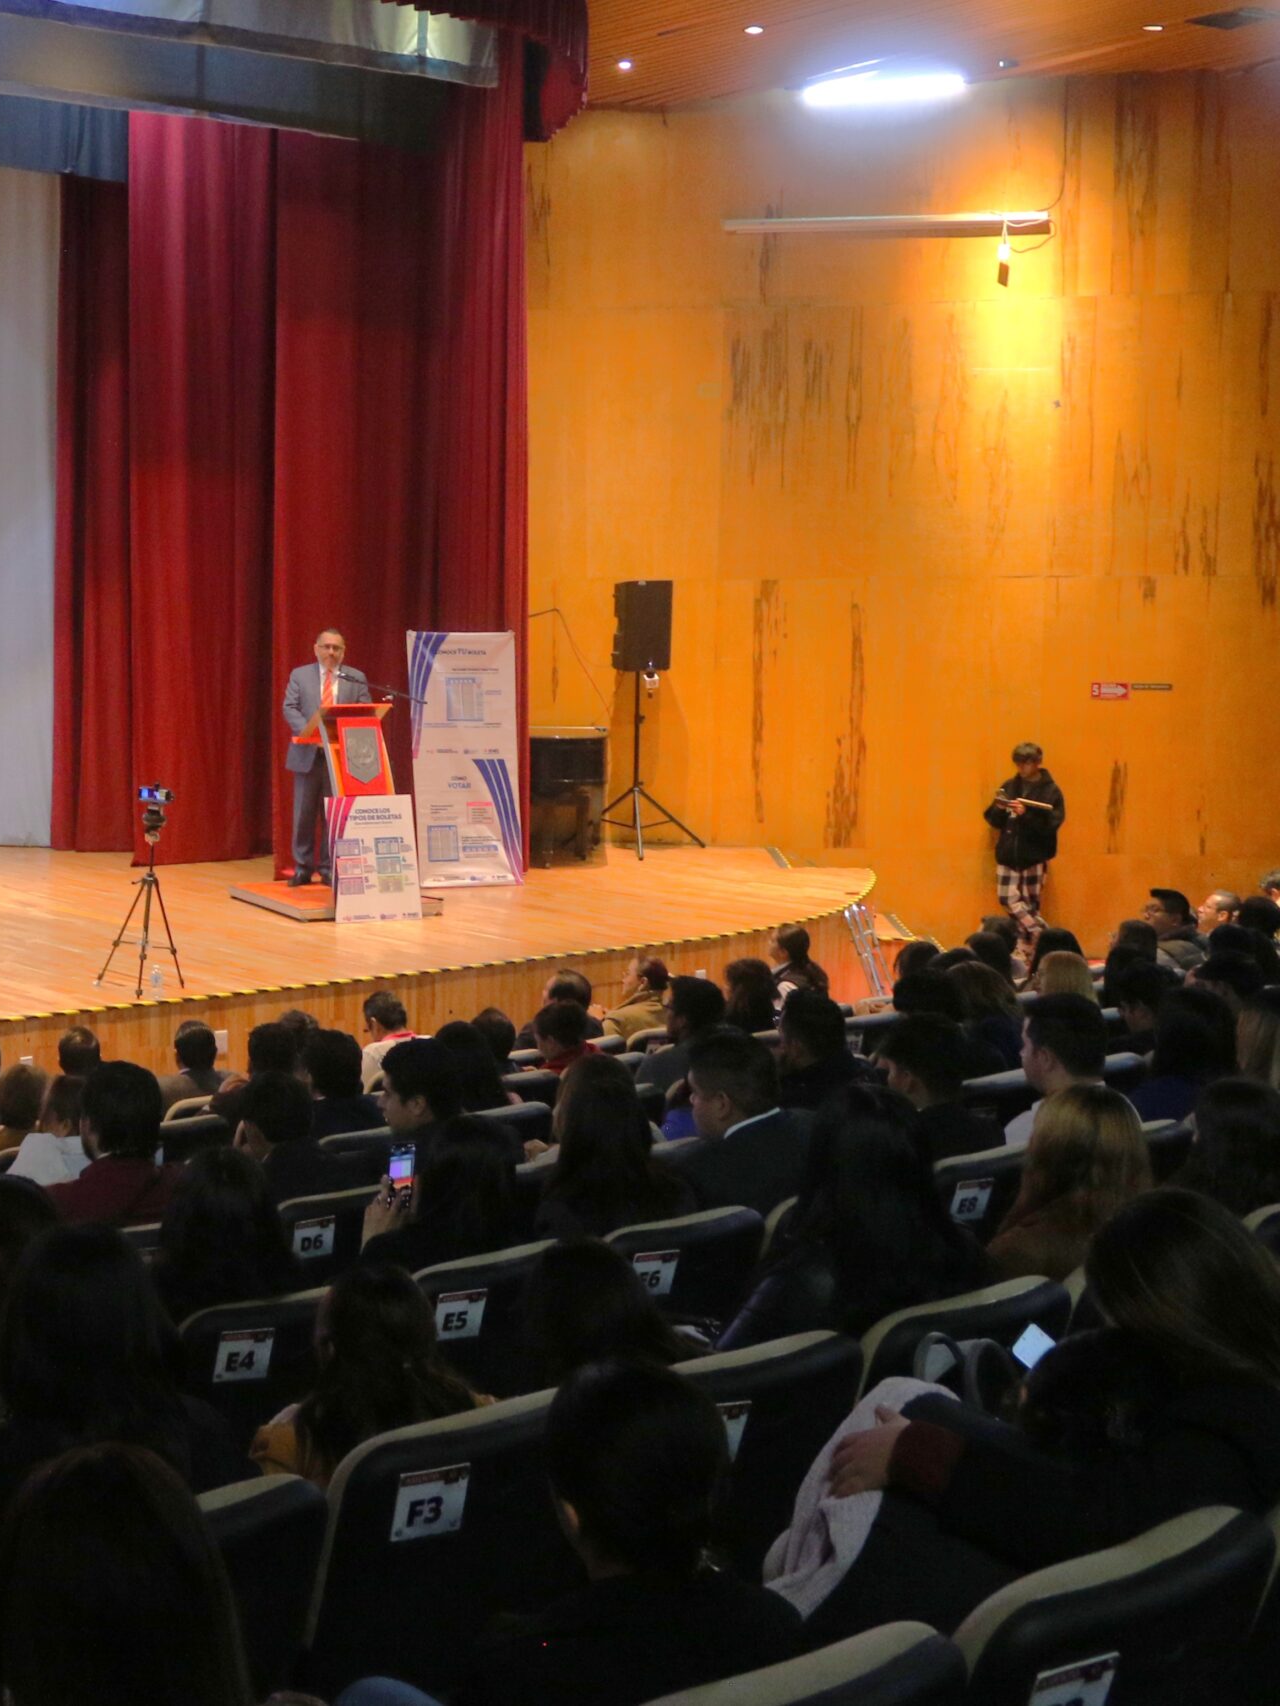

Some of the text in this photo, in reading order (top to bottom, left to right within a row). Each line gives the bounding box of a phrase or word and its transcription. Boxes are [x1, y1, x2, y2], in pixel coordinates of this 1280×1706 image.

[300, 1234, 323, 1252] D6
[441, 1311, 468, 1332] E5
[225, 1350, 256, 1372] E4
[406, 1495, 444, 1528] F3
